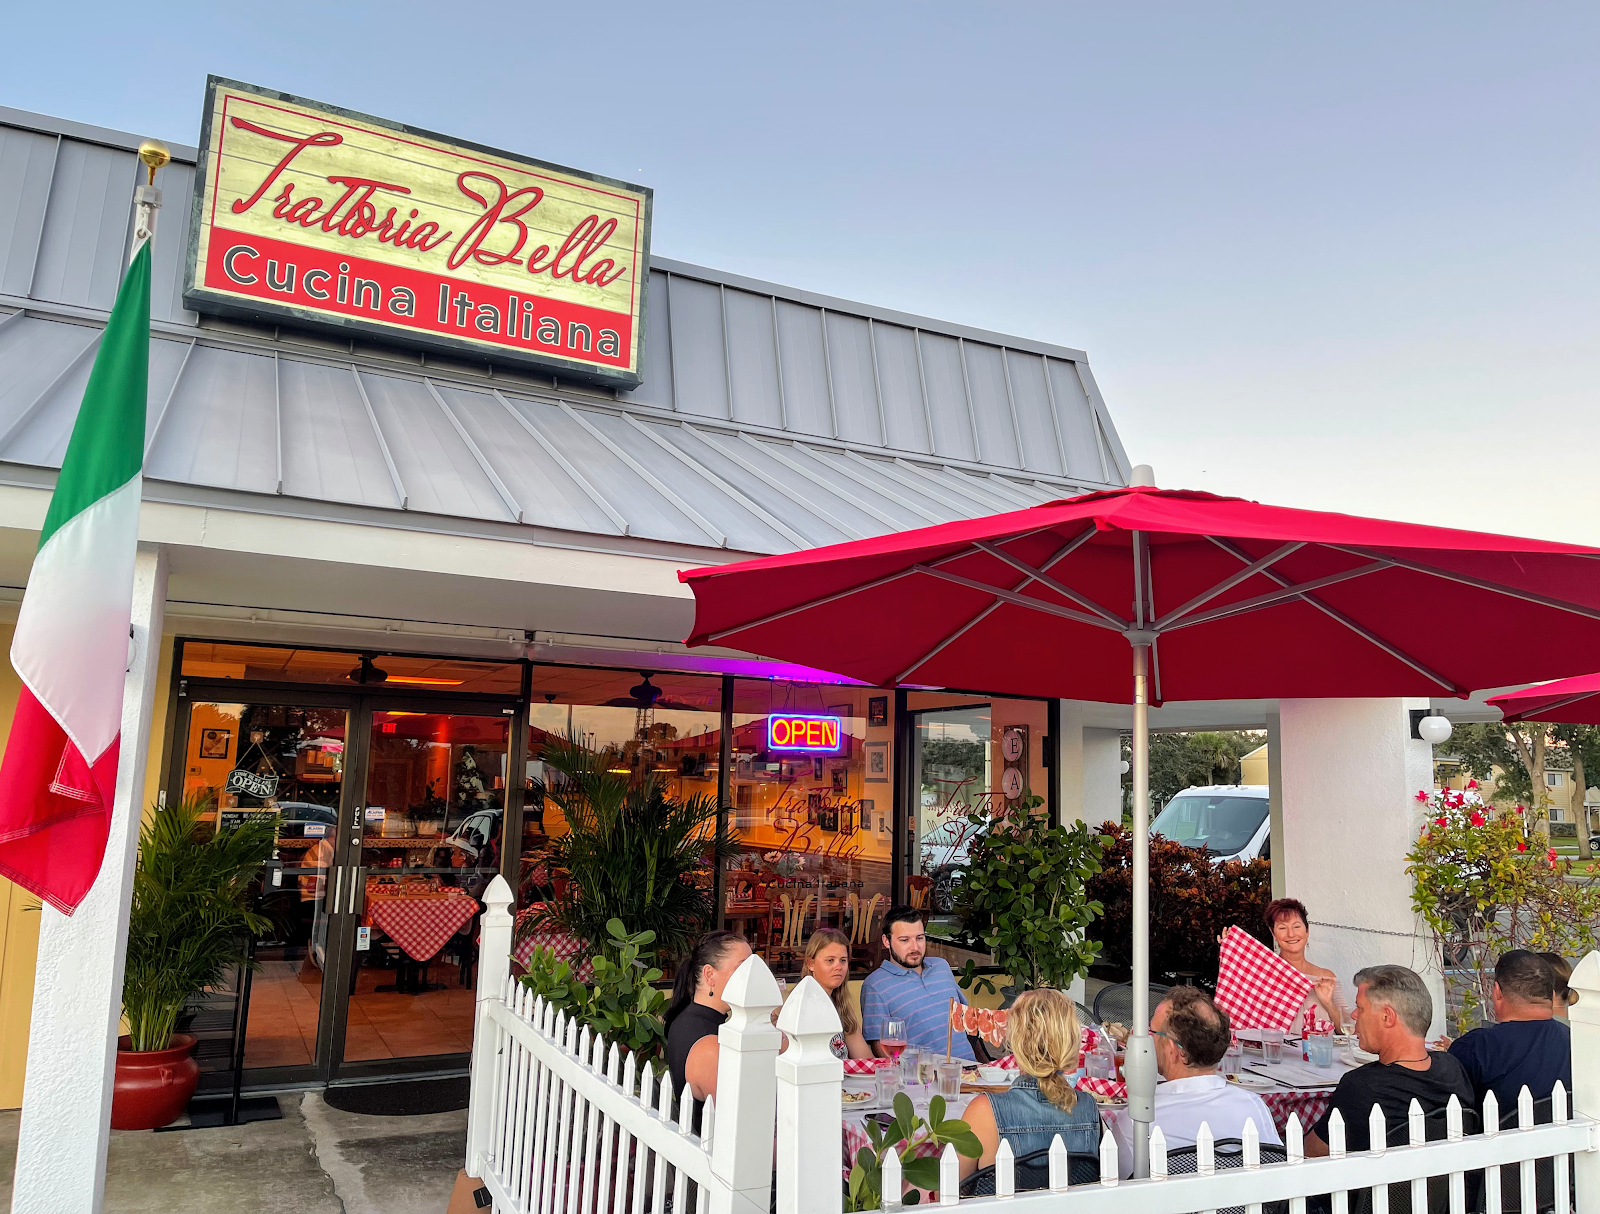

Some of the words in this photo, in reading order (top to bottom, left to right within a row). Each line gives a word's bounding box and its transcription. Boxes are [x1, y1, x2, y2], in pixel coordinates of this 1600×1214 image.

[230, 116, 453, 252] Trattoria
[447, 170, 627, 288] Bella
[222, 244, 417, 319] Cucina
[437, 283, 621, 358] Italiana
[382, 722, 397, 733] EXIT
[772, 719, 837, 746] OPEN
[232, 775, 272, 795] OPEN
[762, 769, 867, 815] Trattoria
[773, 815, 866, 863] Bella
[768, 879, 812, 889] Cucina
